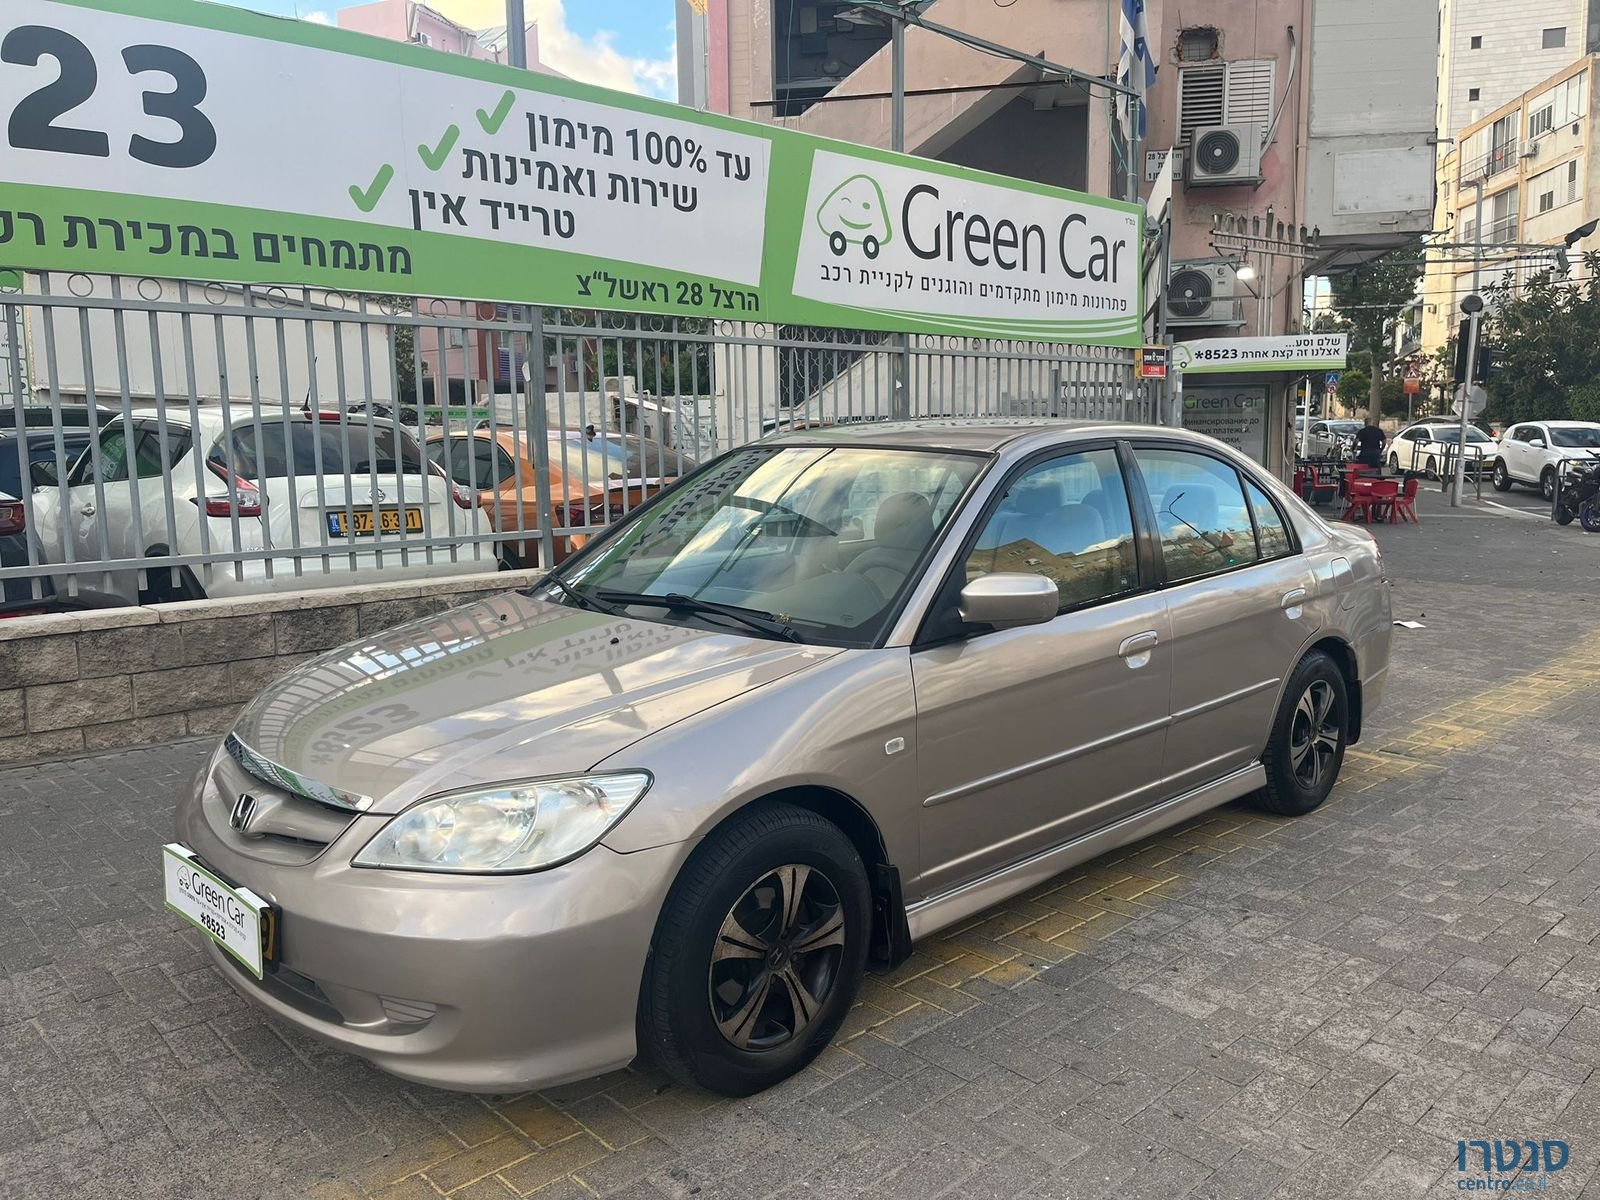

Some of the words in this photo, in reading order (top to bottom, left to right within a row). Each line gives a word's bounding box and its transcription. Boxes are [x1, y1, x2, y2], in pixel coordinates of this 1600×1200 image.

[0, 24, 217, 168] 23
[525, 111, 614, 157] מימון
[626, 128, 707, 173] 100%
[461, 147, 597, 198] ואמינות
[715, 150, 752, 181] עד
[607, 172, 699, 212] שירות
[408, 188, 469, 231] אין
[479, 198, 576, 239] טרייד
[63, 215, 240, 260] במכירת
[901, 184, 1046, 274] Green
[1058, 213, 1126, 284] Car
[252, 231, 412, 275] מתמחים
[820, 264, 852, 284] רכב
[859, 270, 914, 293] לקניית
[920, 276, 973, 296] והוגנים
[675, 280, 704, 306] 28
[708, 283, 760, 311] הרצל
[979, 282, 1041, 304] מתקדמים
[1045, 290, 1078, 308] מימון
[1082, 294, 1127, 311] פתרונות
[1240, 349, 1269, 359] אחרת
[1271, 348, 1294, 359] קצת
[1296, 348, 1308, 357] זה
[1311, 346, 1340, 357] אצלנו
[1317, 336, 1341, 347] שלם
[1183, 394, 1230, 409] Green
[1233, 393, 1261, 408] Car
[191, 872, 226, 914] Green
[226, 896, 245, 929] Car
